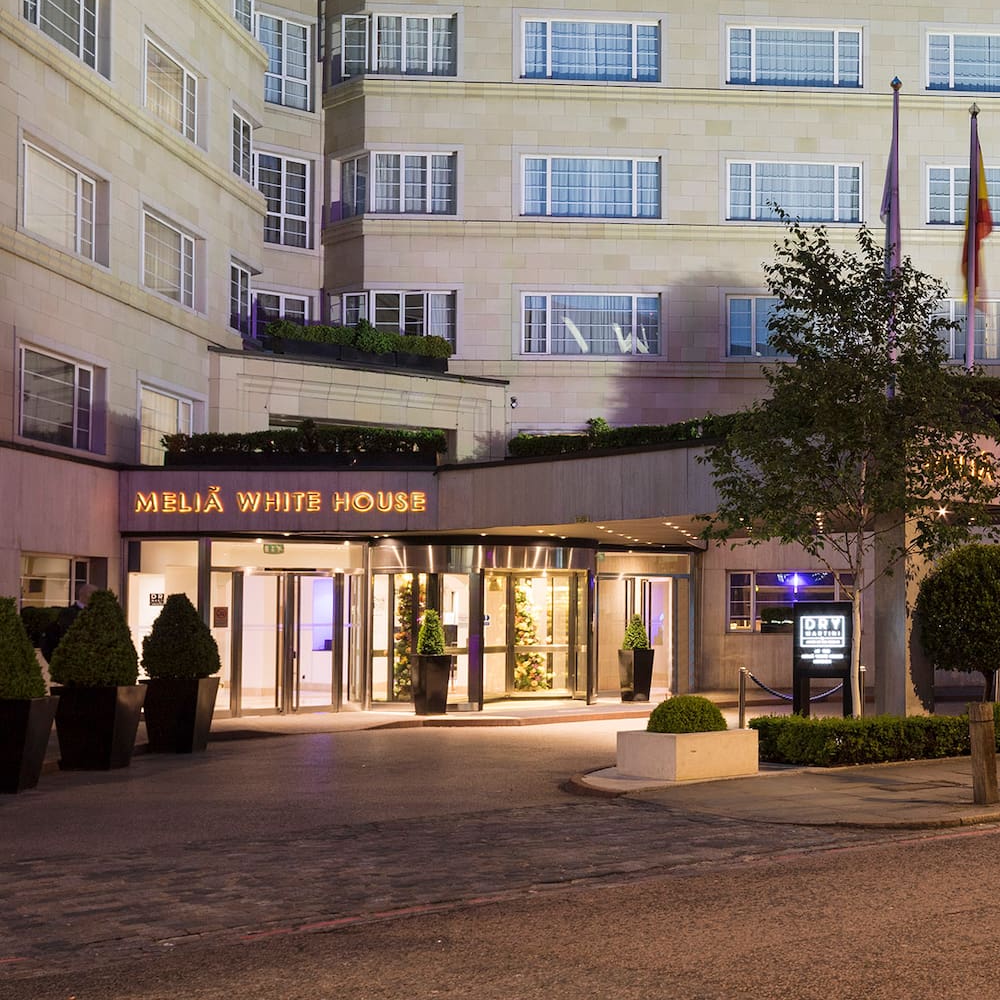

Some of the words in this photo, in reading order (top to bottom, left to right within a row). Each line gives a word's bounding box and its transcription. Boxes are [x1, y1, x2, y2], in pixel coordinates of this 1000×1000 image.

[236, 491, 321, 513] WHITE
[333, 491, 427, 513] HOUSE
[804, 618, 841, 630] DRY
